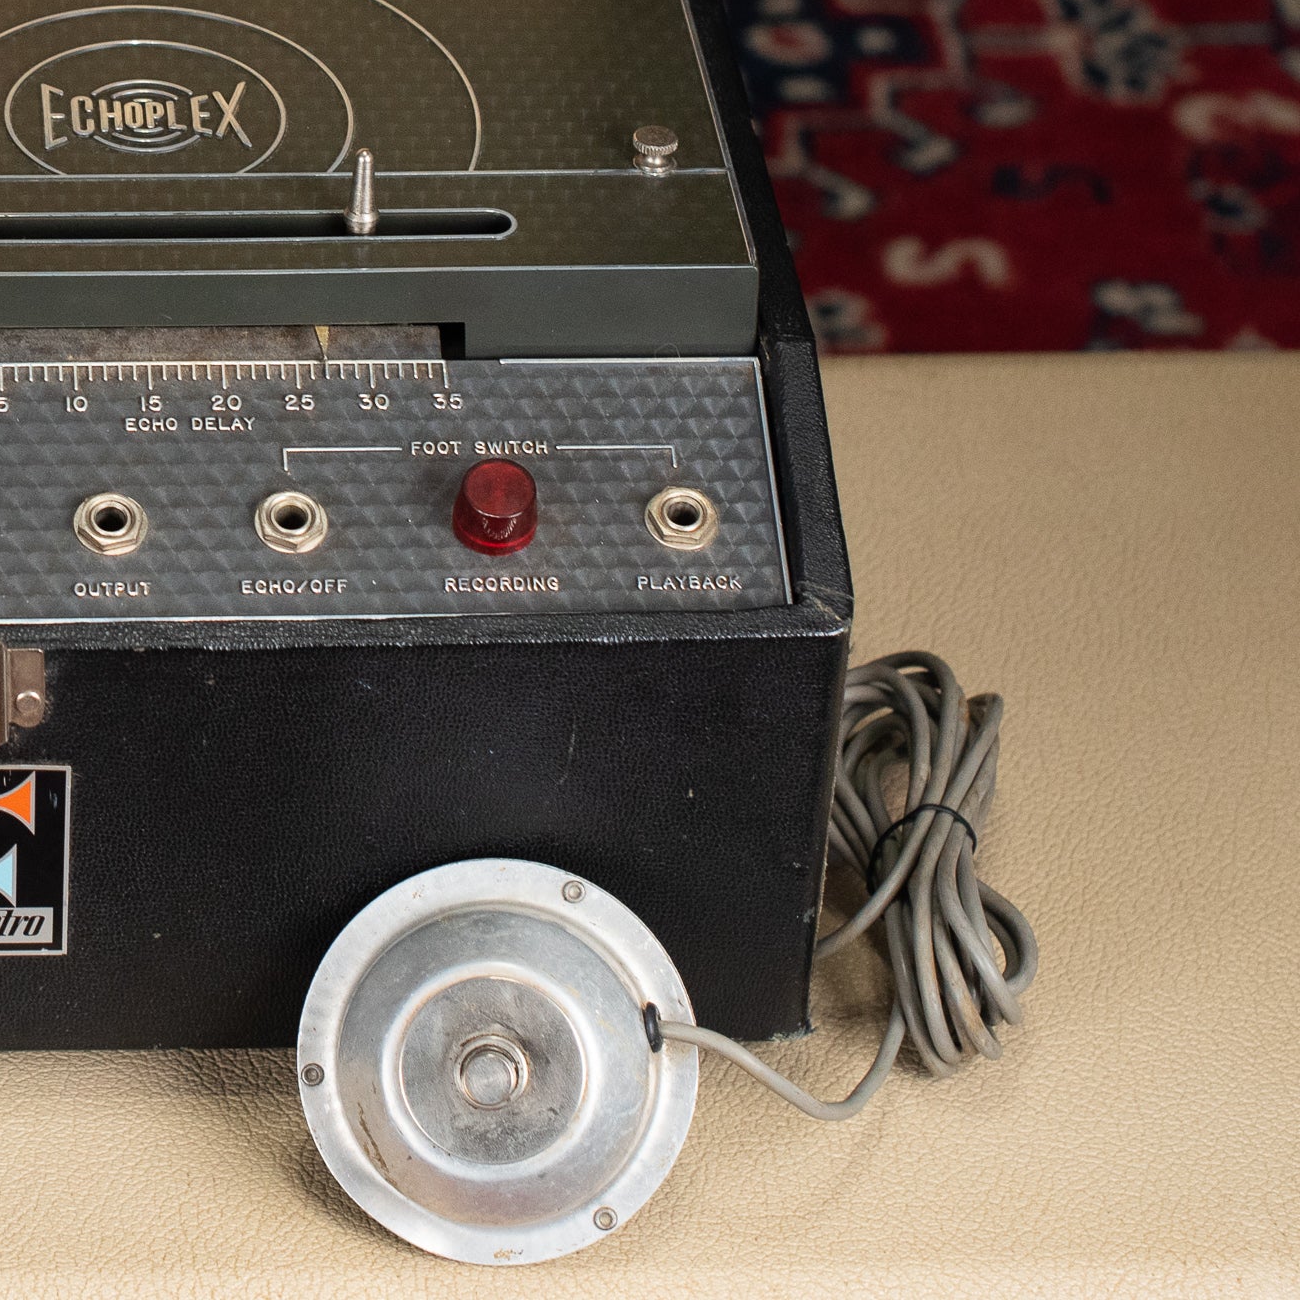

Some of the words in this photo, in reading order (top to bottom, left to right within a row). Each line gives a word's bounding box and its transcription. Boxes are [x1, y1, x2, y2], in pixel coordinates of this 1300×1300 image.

[41, 81, 252, 149] ECHOPLEX
[66, 396, 88, 412] 10
[141, 396, 162, 412] 15
[211, 395, 242, 411] 20
[285, 394, 315, 411] 25
[358, 393, 390, 410] 30
[433, 393, 463, 410] 35
[125, 417, 178, 432] ECHO
[192, 416, 255, 431] DELAY
[411, 440, 461, 456] FOOT
[475, 440, 548, 455] SWITCH
[74, 582, 151, 598] OUTPUT
[241, 579, 349, 595] ECHO/OFF
[444, 576, 559, 593] RECORDING
[638, 575, 742, 591] PLAYBACK
